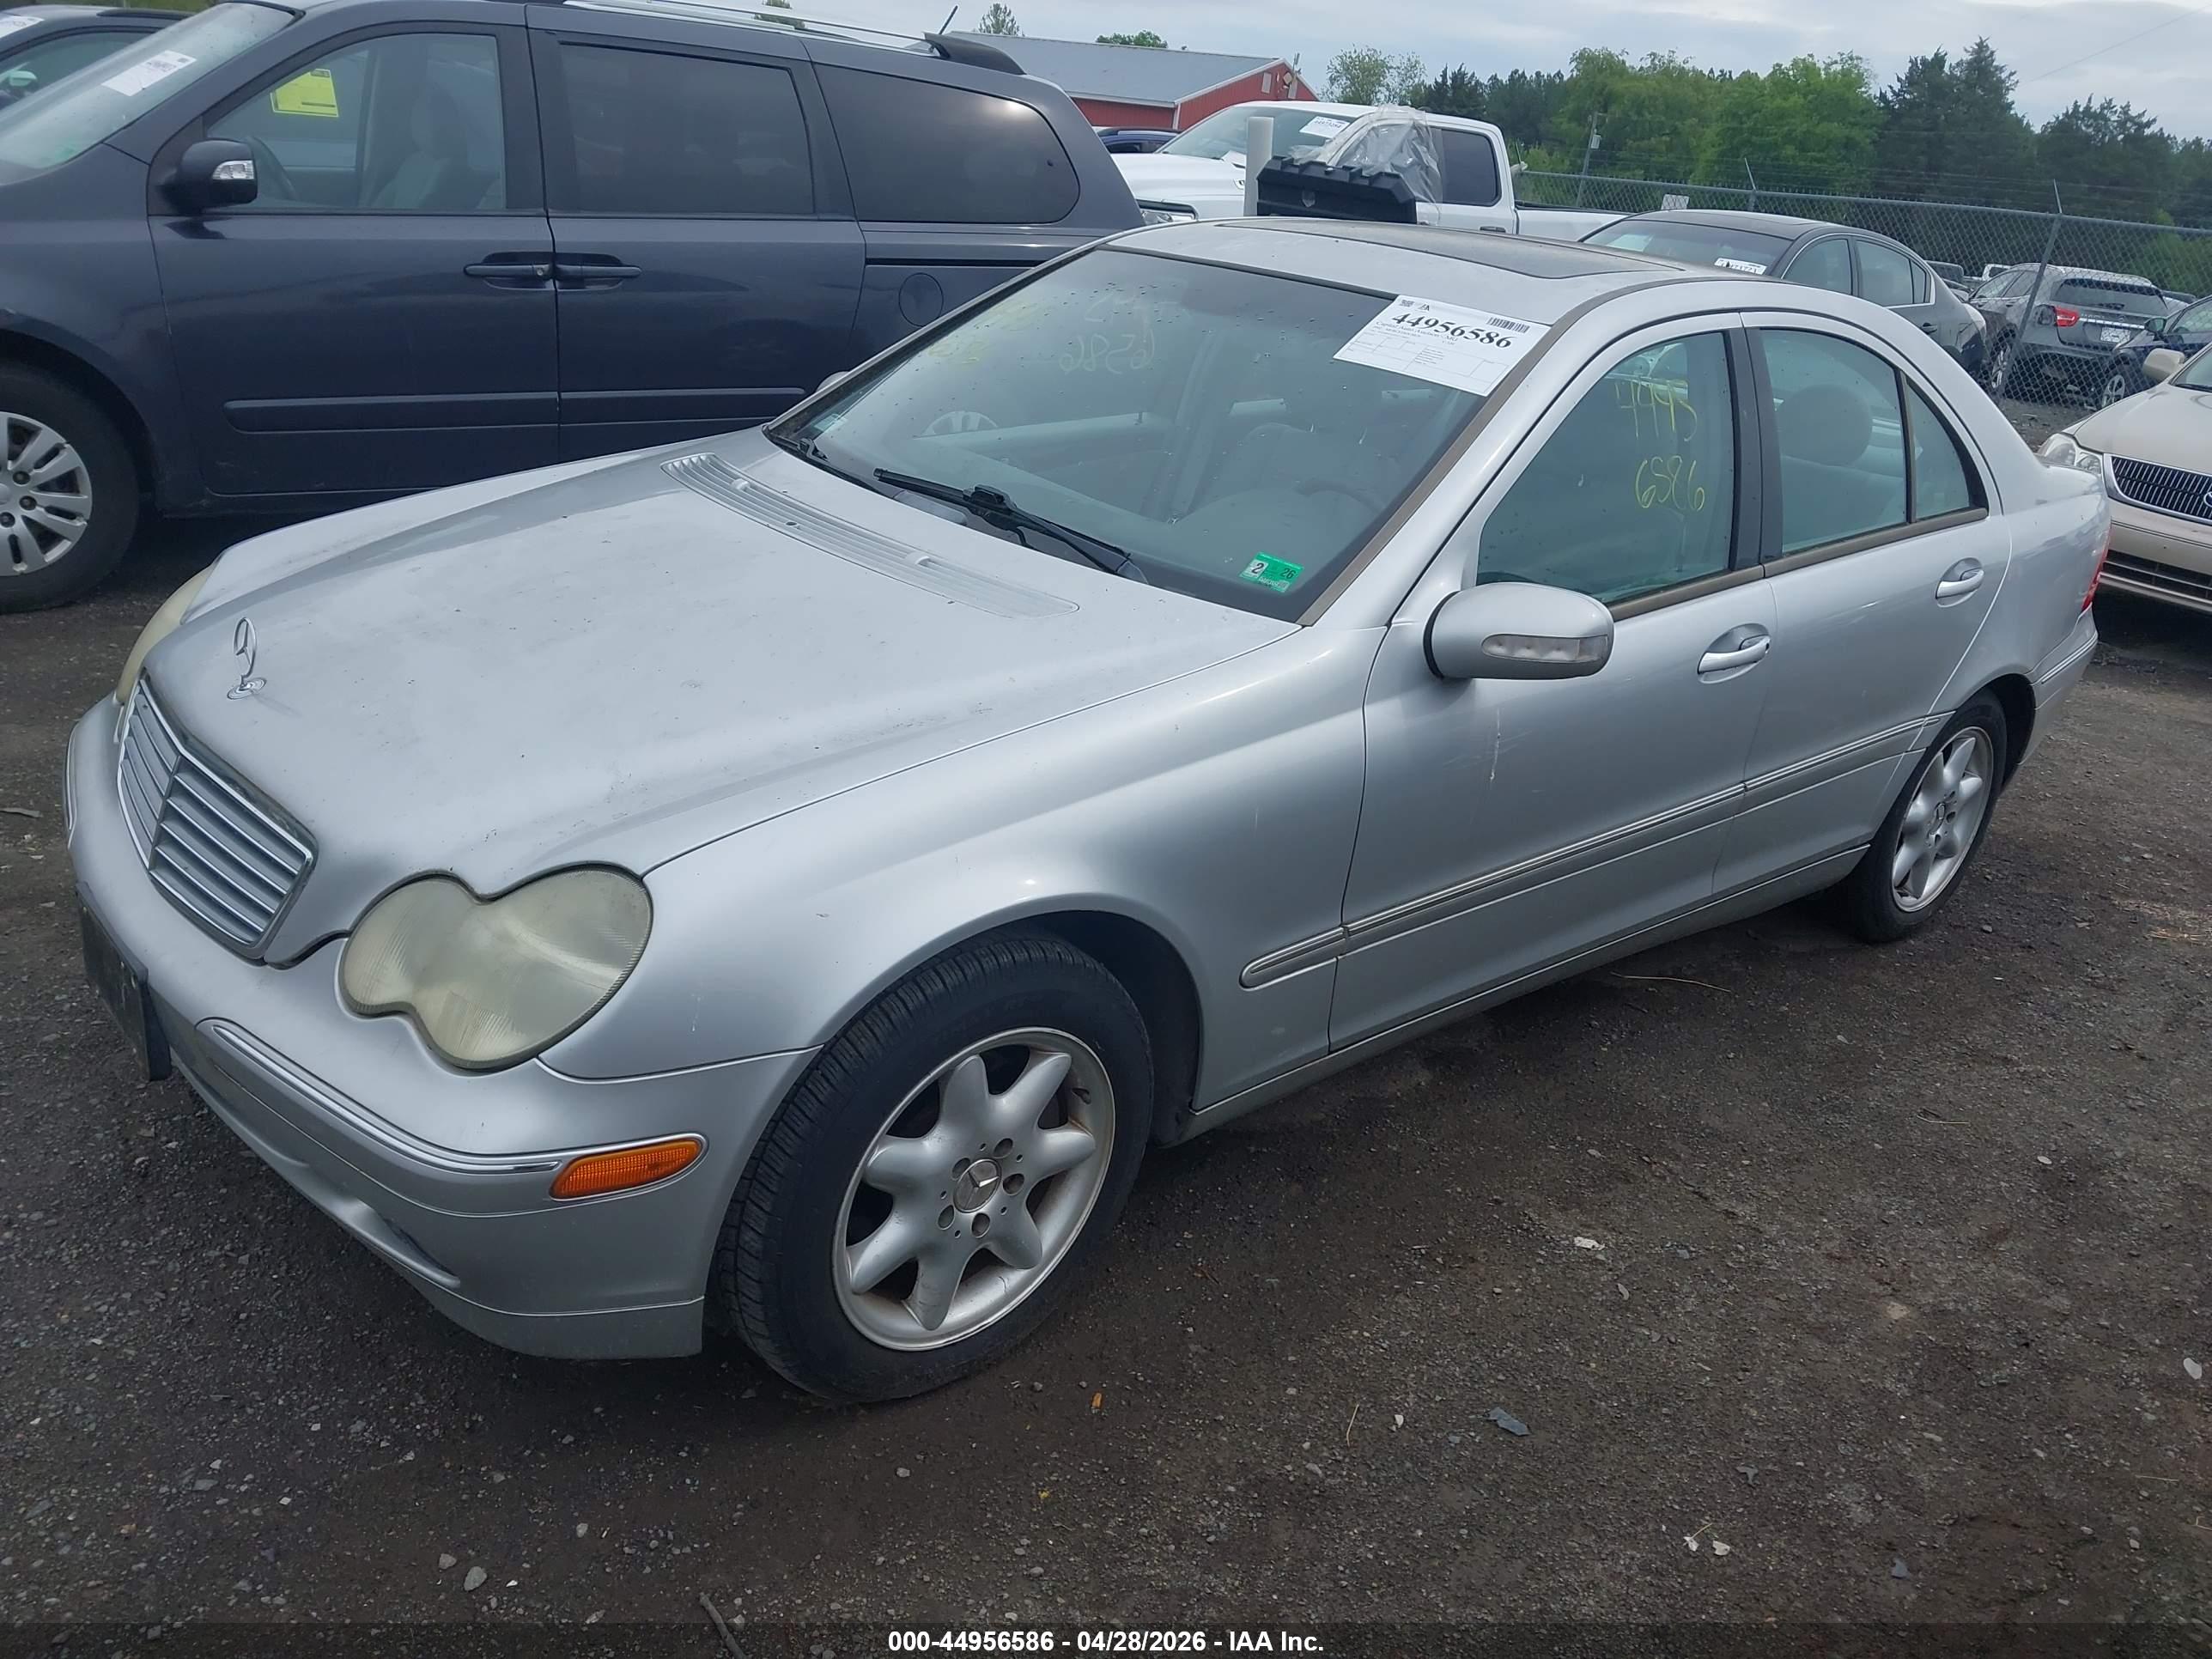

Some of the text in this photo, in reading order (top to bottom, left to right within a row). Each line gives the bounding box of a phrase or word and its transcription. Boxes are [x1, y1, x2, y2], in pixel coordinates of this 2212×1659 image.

[1392, 313, 1517, 349] 44956586
[1635, 454, 1705, 513] 6586
[1252, 562, 1265, 574] 2
[1280, 568, 1297, 580] 26
